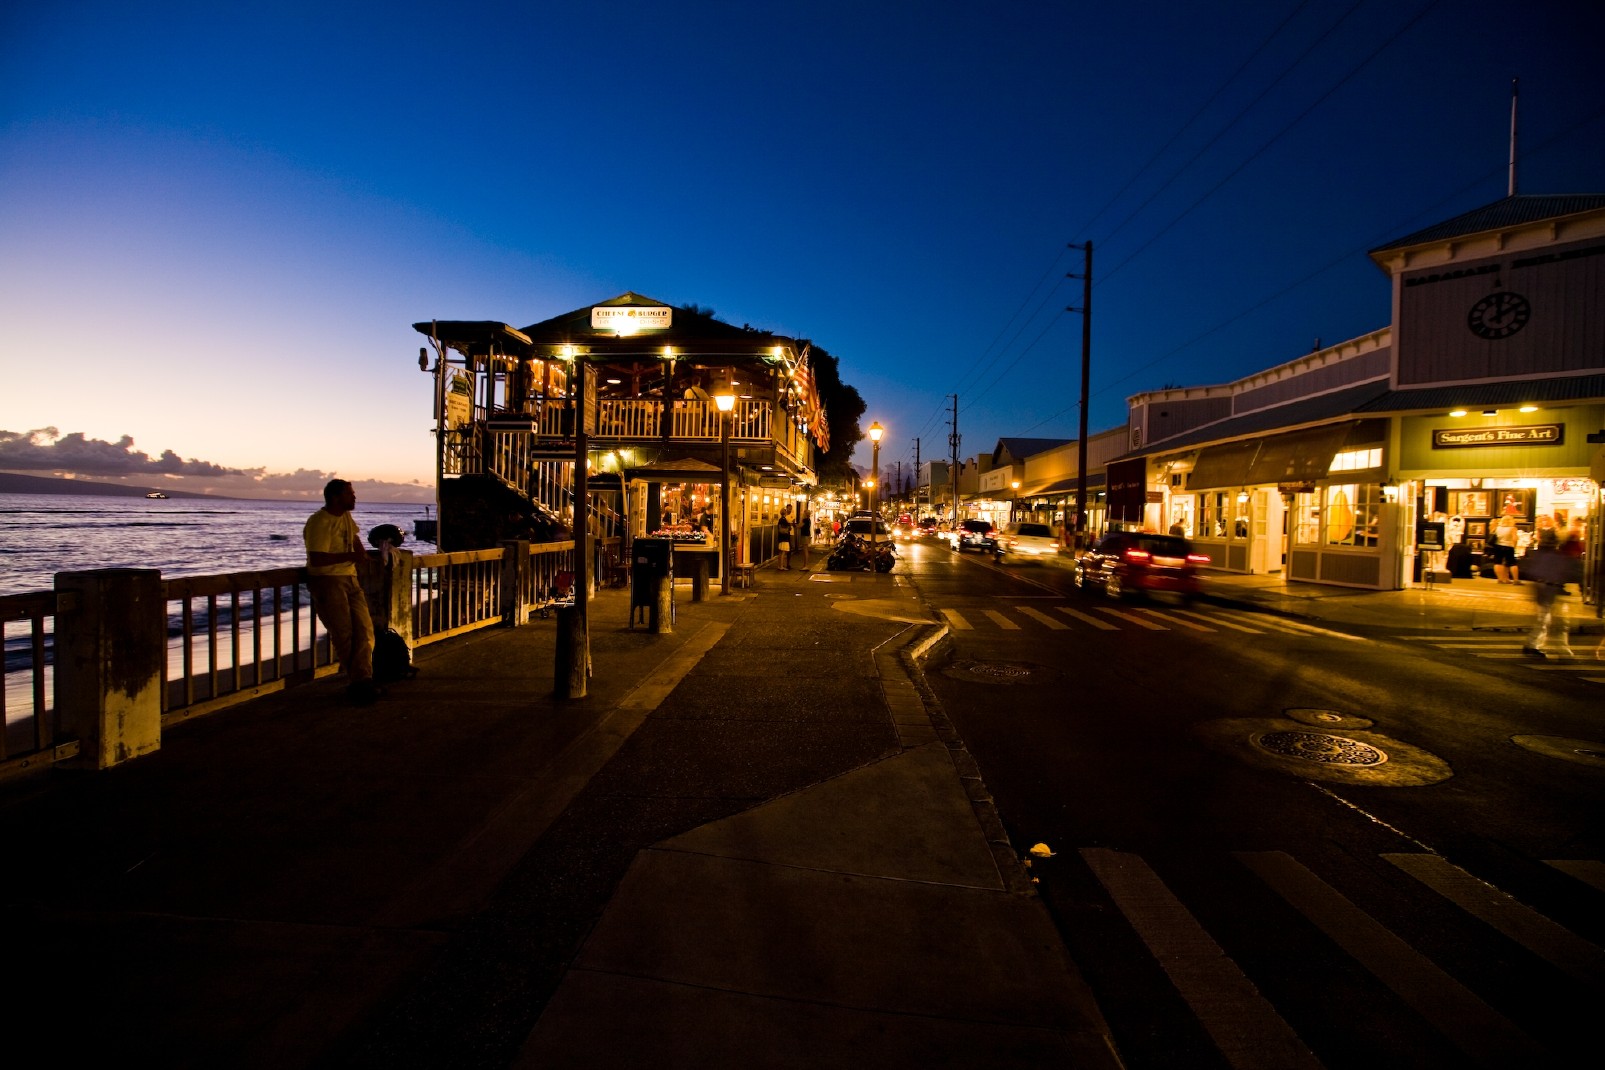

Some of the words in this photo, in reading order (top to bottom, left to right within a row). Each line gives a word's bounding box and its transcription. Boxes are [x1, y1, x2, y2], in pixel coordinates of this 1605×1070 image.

[1441, 432, 1495, 443] Sargent's
[1497, 430, 1526, 440] Fine
[1528, 429, 1552, 439] Art
